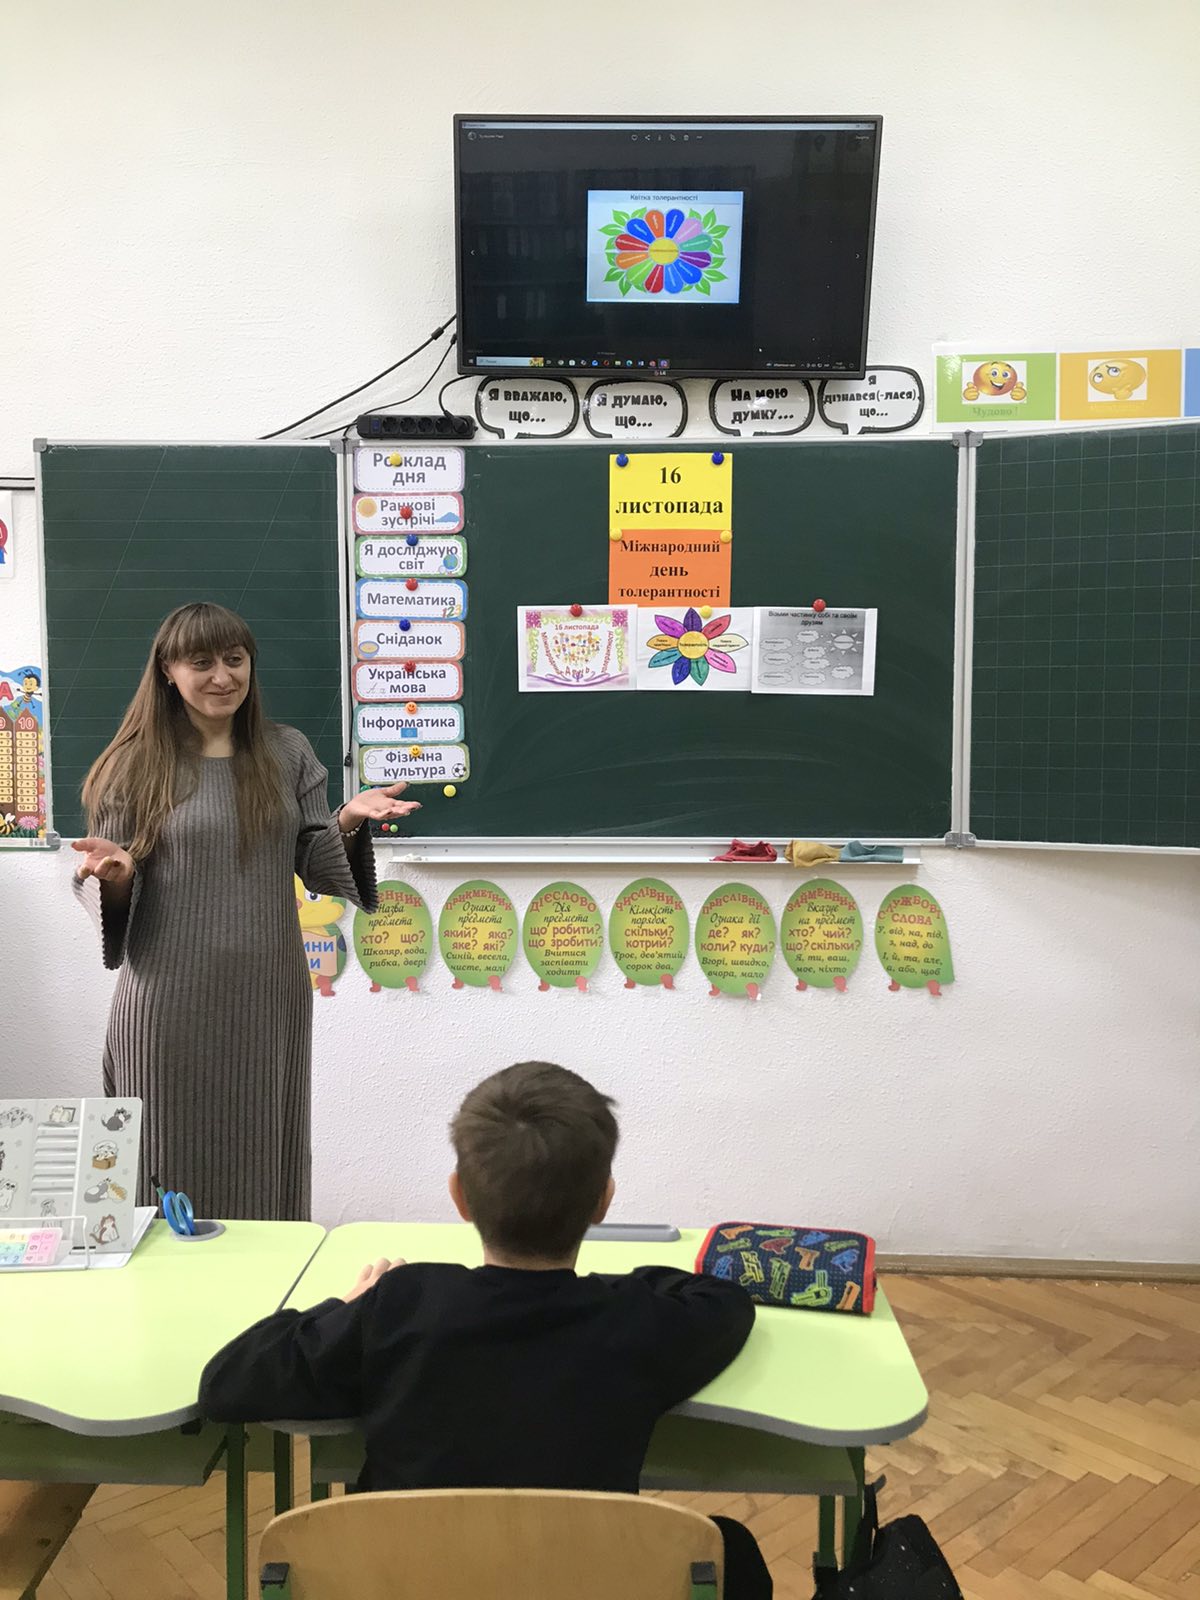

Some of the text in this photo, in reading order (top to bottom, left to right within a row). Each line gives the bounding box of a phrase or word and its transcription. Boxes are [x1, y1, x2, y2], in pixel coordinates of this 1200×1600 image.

[868, 375, 877, 385] Я
[488, 388, 499, 401] Я
[373, 452, 447, 470] Роклад
[392, 472, 426, 486] дня
[660, 466, 682, 484] 16
[380, 498, 436, 511] Ранкові
[615, 500, 723, 514] листопада
[364, 544, 458, 558] Я досліджую
[619, 539, 720, 555] Міжнародний
[399, 558, 425, 570] світ
[649, 565, 689, 578] день
[367, 592, 456, 606] Математика
[618, 586, 720, 600] толерантності
[376, 632, 443, 647] Сніданок
[368, 668, 446, 682] Українська
[389, 683, 426, 693] мова
[18, 716, 35, 730] 10
[361, 716, 456, 730] Інформатика
[385, 751, 443, 763] Фізична
[383, 765, 446, 779] культура
[377, 889, 423, 907] ЕННИК
[529, 890, 597, 912] ДІЄСЛОВО
[891, 912, 932, 925] СЛОВА
[360, 930, 426, 944] хто? що?
[443, 927, 514, 940] який? яка?
[530, 923, 601, 937] що робити?
[624, 925, 675, 937] скільки?
[708, 926, 761, 939] де? як?
[788, 926, 852, 939] хто? чий?
[452, 939, 506, 951] яке? які?
[528, 935, 604, 950] що зробити?
[626, 937, 674, 951] котрий?
[700, 940, 775, 956] коли? куди?
[786, 939, 861, 951] що? скільки?
